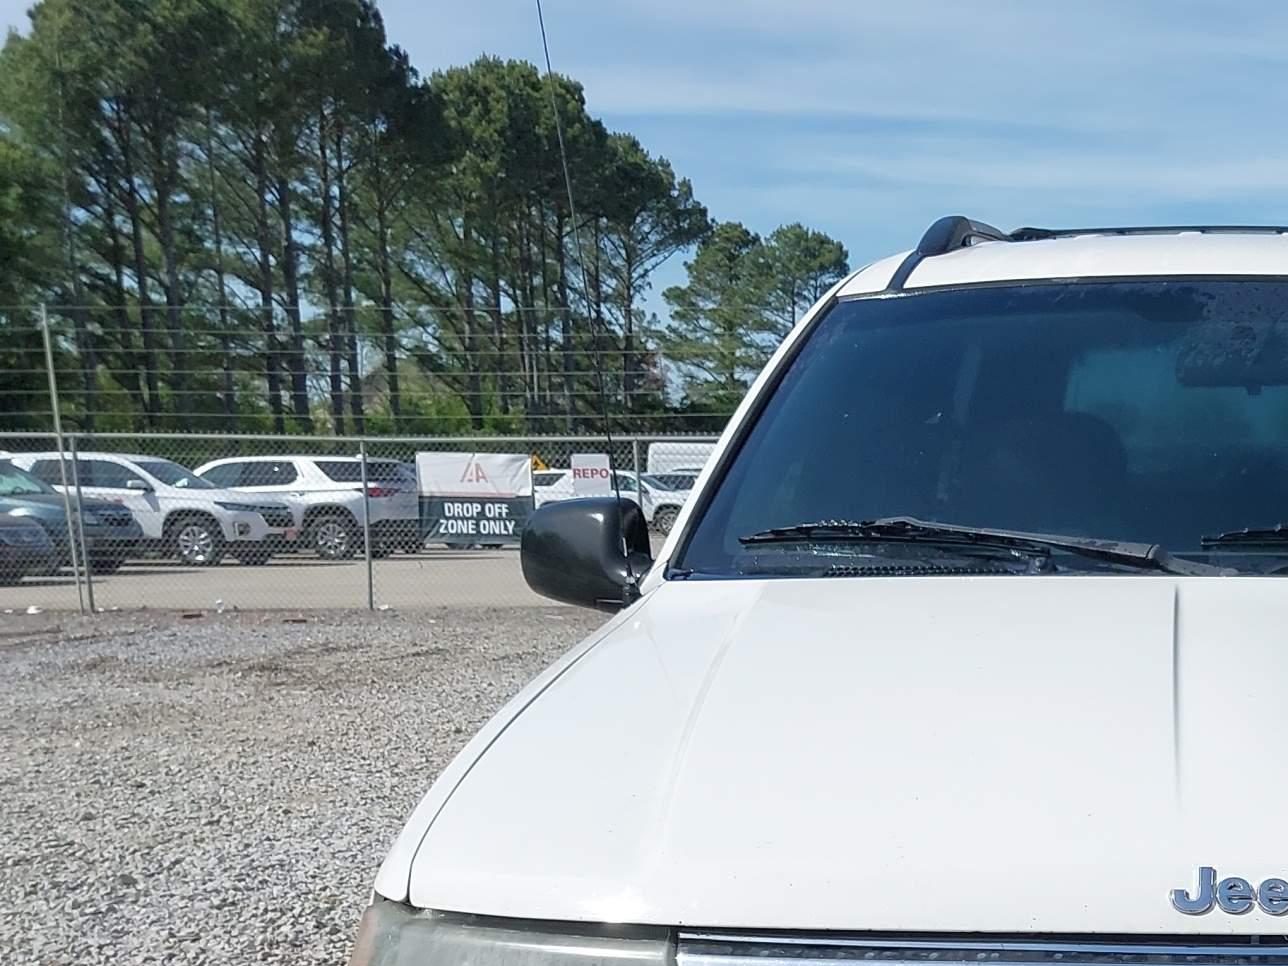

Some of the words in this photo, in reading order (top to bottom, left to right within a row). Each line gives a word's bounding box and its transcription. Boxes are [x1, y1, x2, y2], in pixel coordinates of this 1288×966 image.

[572, 468, 610, 480] REPO
[444, 502, 482, 518] DROP
[485, 503, 509, 518] OFF
[439, 519, 477, 535] ZONE
[480, 519, 516, 535] ONLY
